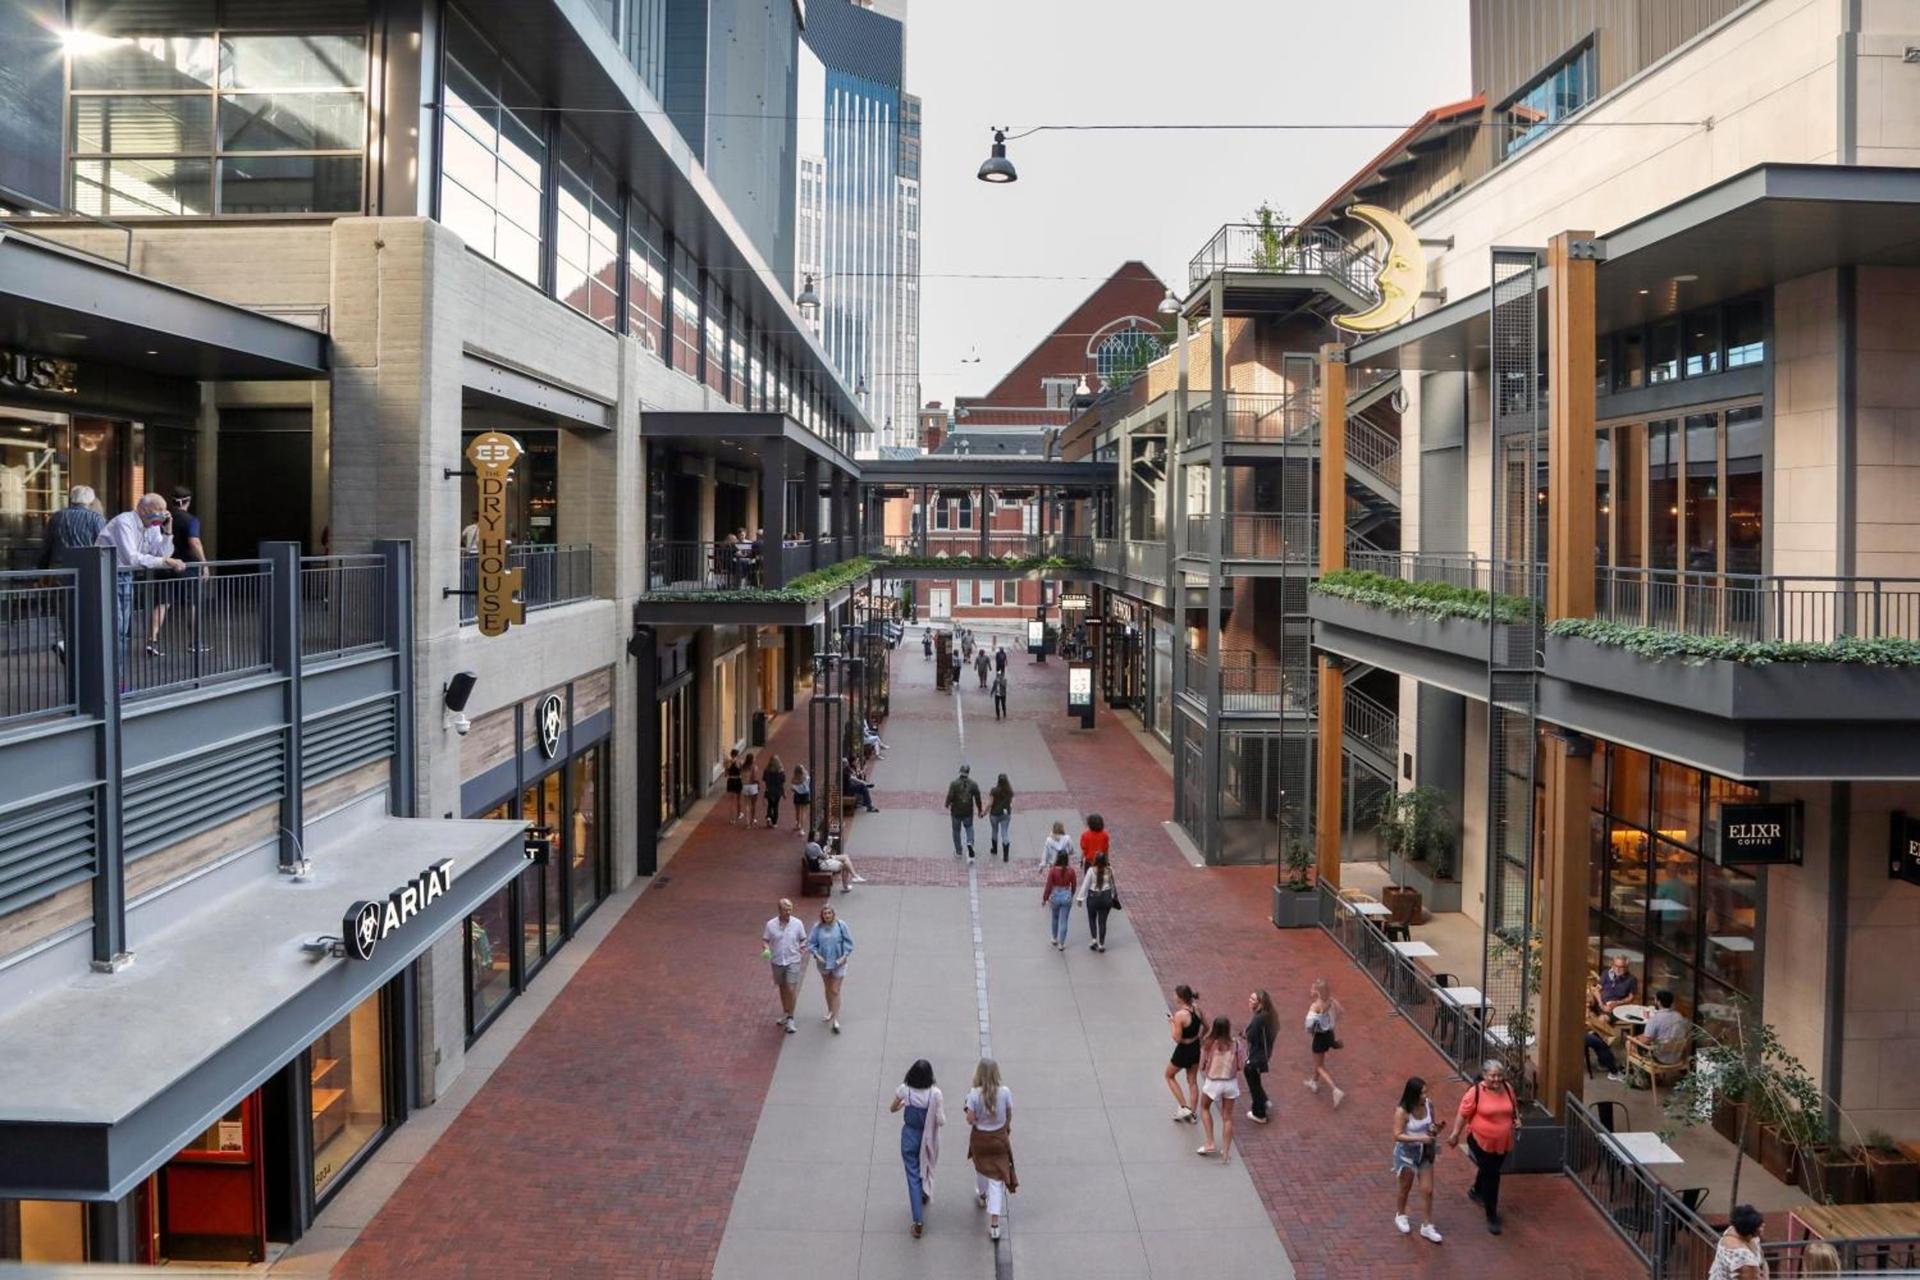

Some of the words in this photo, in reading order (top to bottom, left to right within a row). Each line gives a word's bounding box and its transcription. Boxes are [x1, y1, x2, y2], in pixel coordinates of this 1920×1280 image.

[481, 478, 503, 531] DRY
[481, 538, 503, 630] HOUSE
[1728, 823, 1781, 839] ELIXR
[1737, 838, 1772, 846] COFFEE
[382, 859, 455, 939] ARIAT
